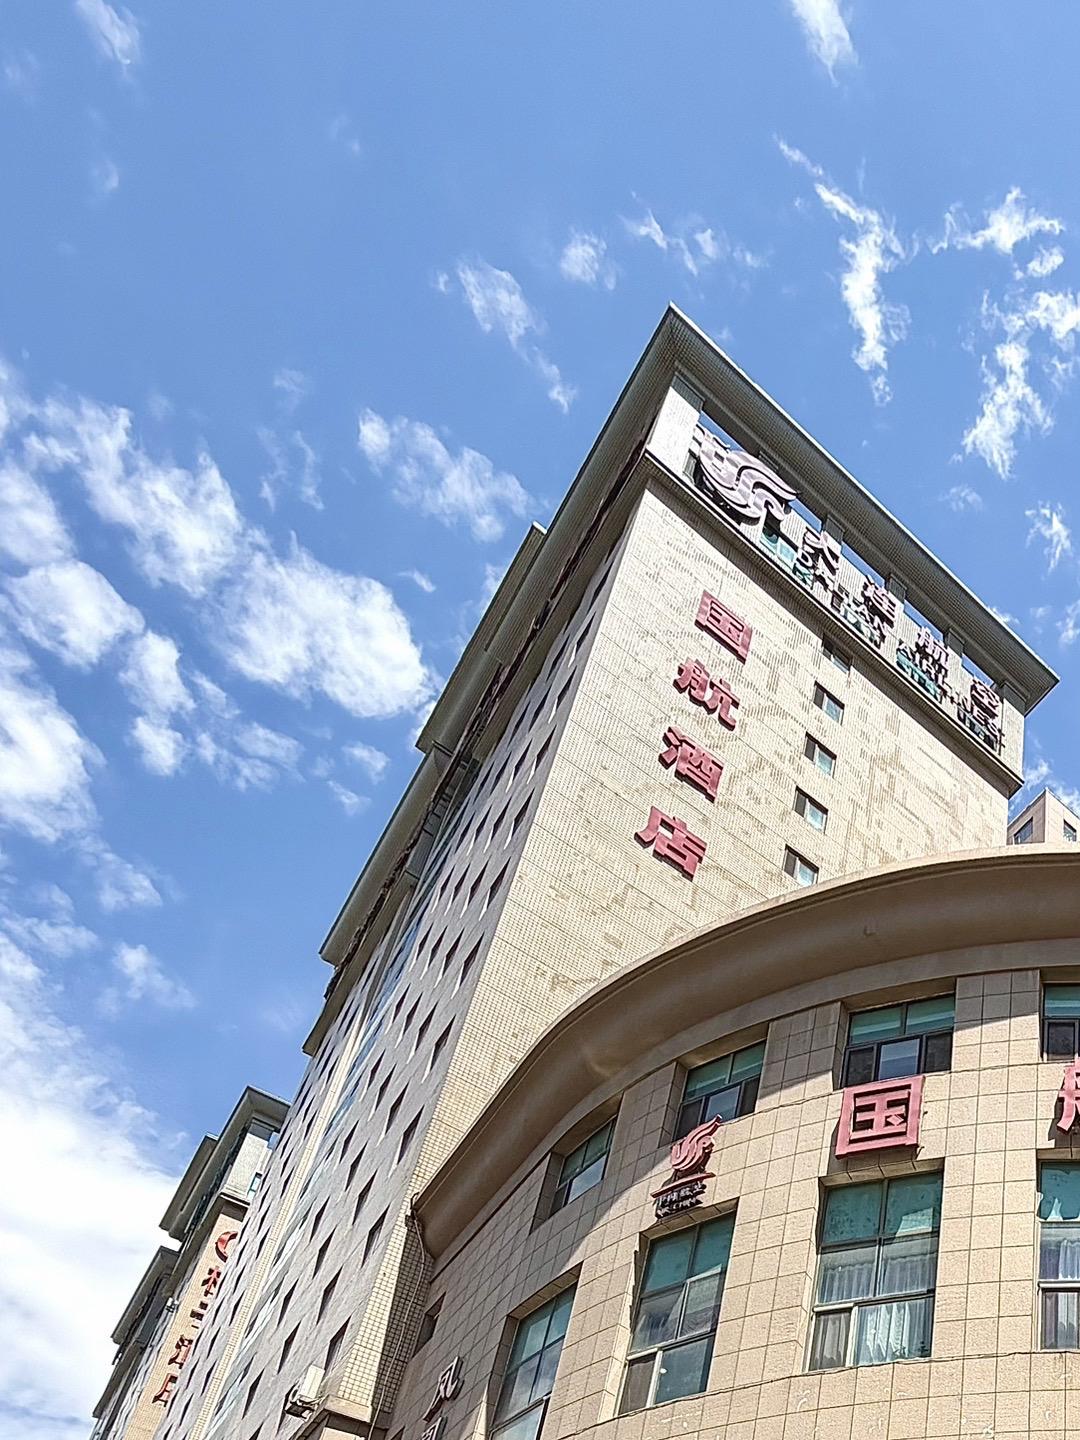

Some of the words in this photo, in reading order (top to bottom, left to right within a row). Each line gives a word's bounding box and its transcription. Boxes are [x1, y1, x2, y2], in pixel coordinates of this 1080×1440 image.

[634, 590, 754, 880] 国航酒店
[803, 526, 1001, 717] 大连航空
